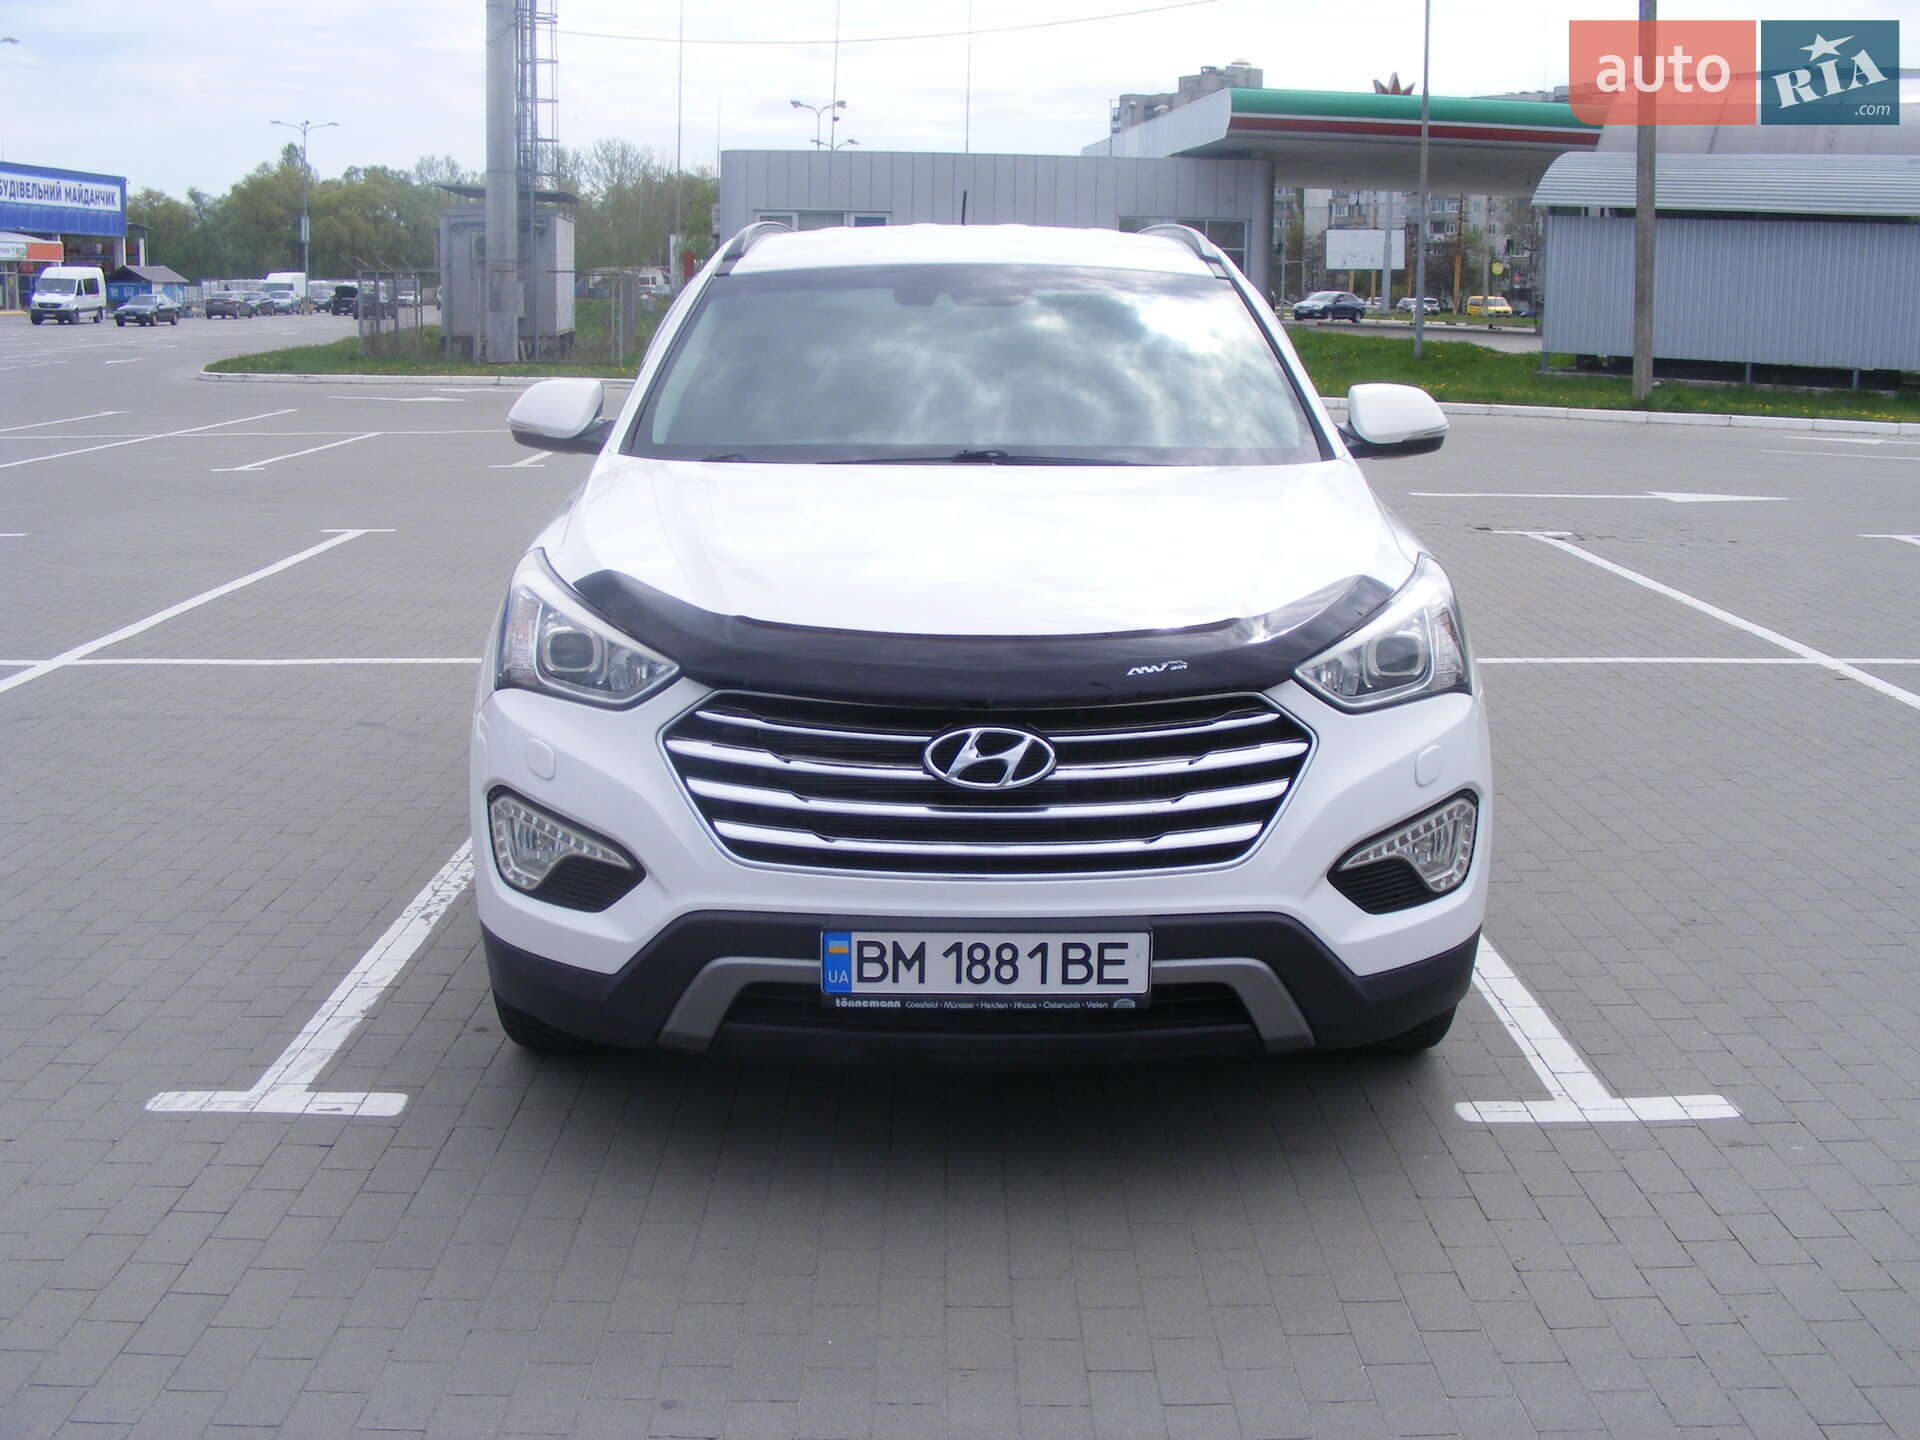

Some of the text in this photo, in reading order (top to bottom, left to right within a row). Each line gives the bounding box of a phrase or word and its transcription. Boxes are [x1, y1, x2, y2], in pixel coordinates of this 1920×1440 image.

[64, 184, 116, 207] МАЙДАНЧИК
[856, 941, 1129, 985] BM 1881 BE
[828, 970, 849, 983] UA
